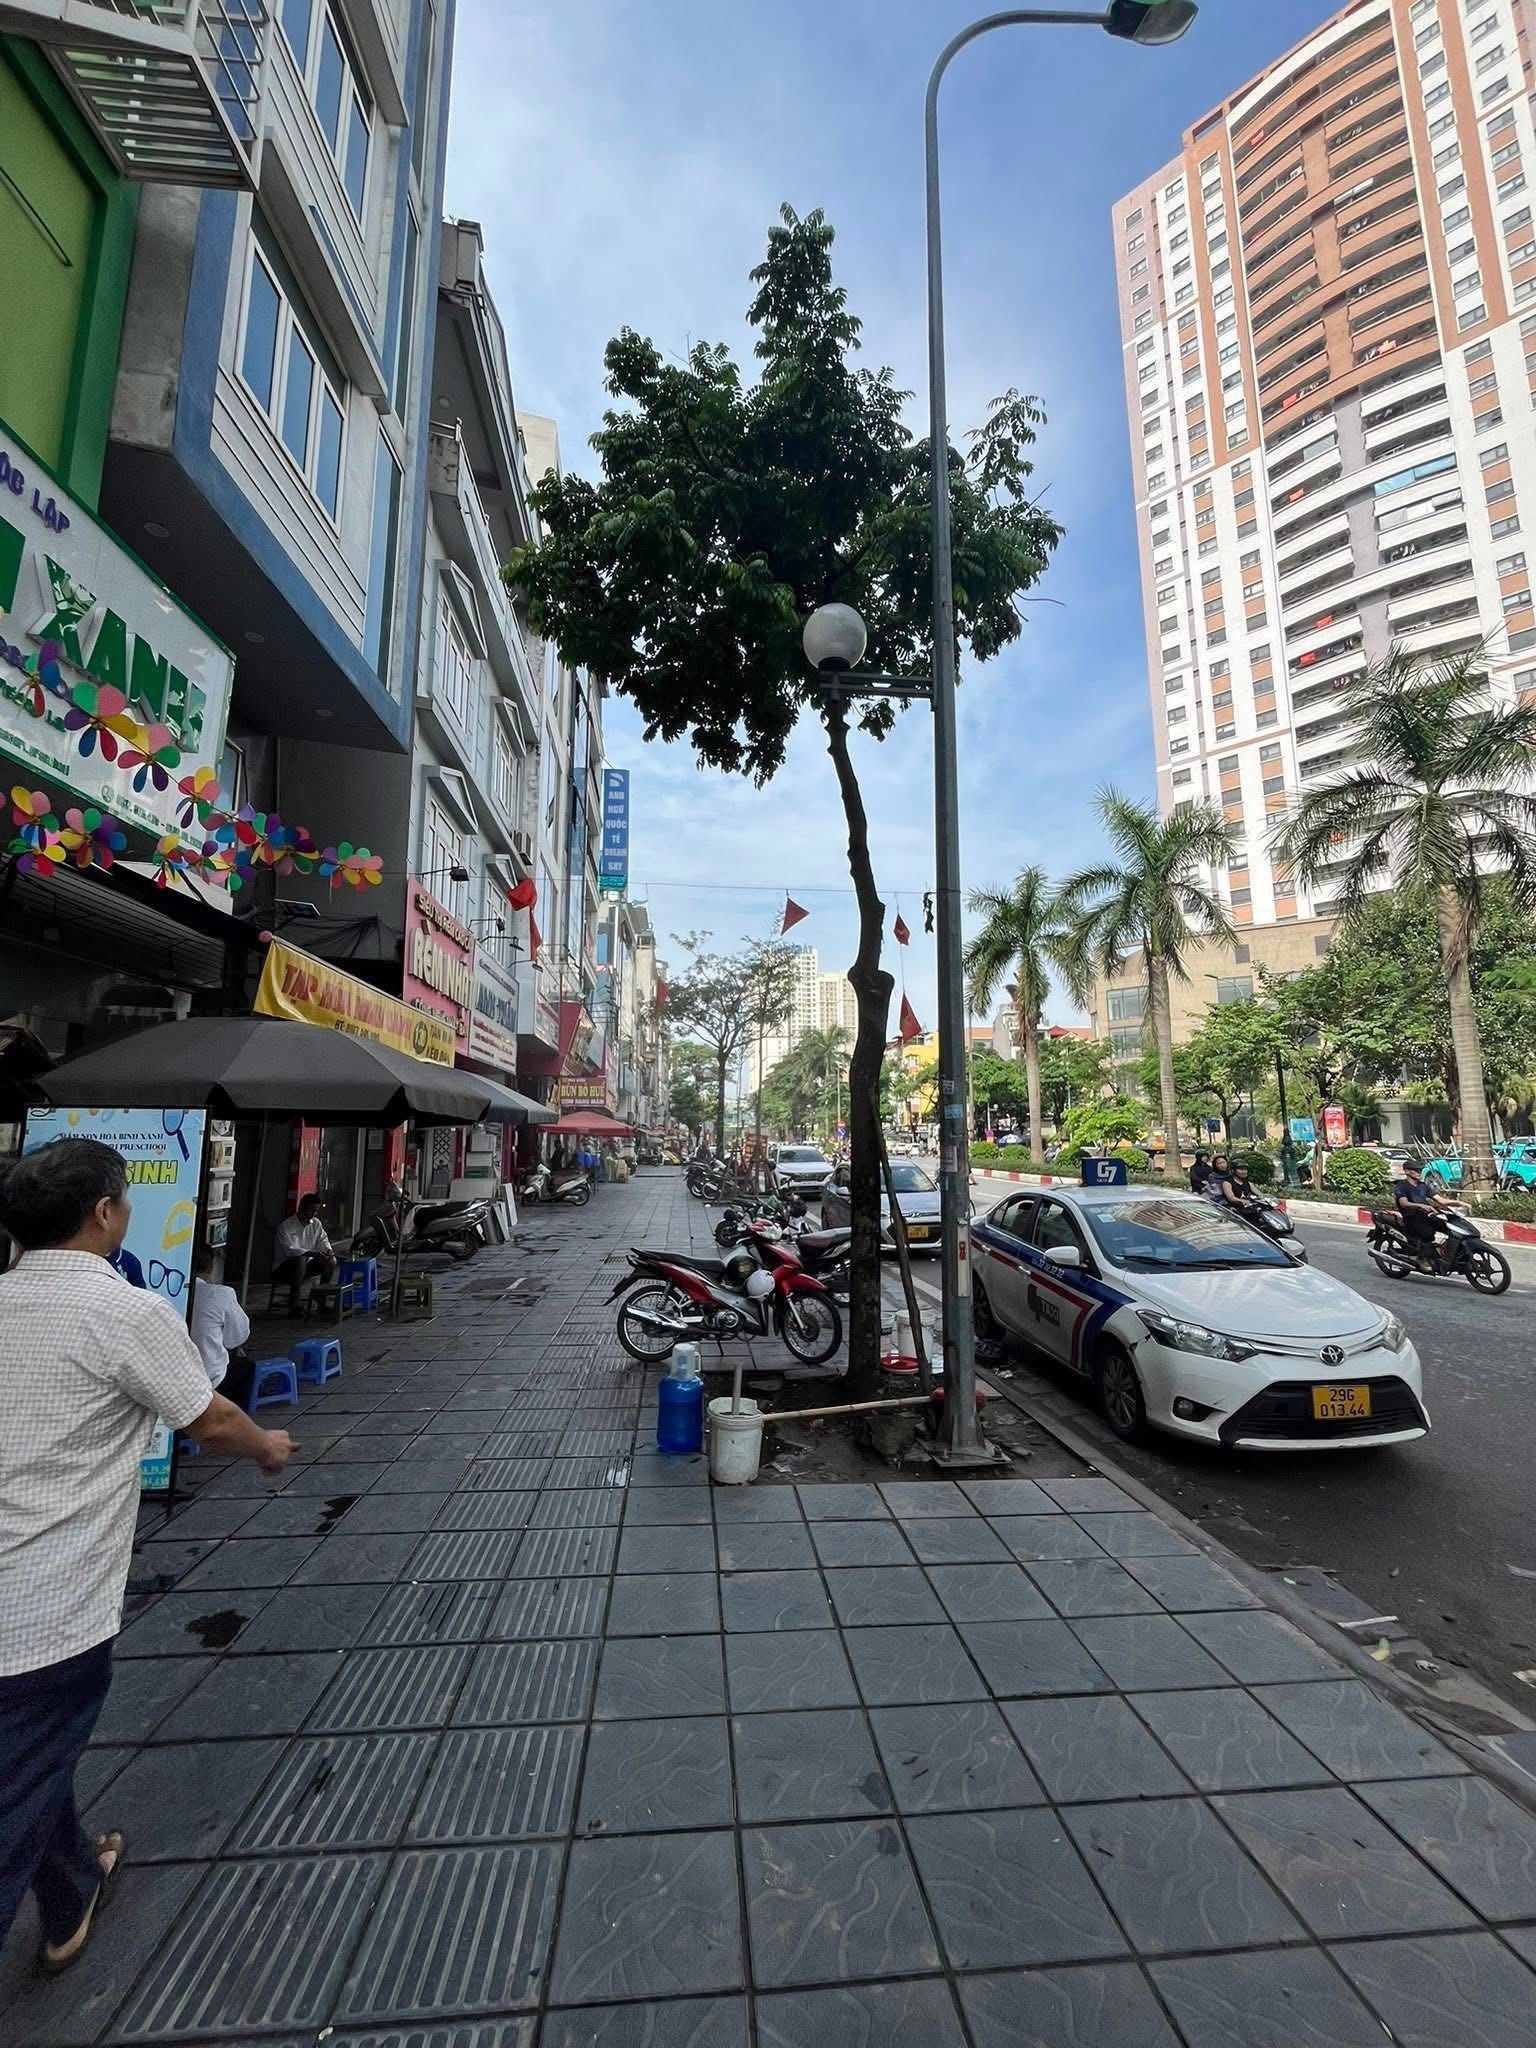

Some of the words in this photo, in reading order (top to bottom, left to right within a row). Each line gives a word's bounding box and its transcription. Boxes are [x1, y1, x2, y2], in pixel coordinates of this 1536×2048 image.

[1097, 1161, 1117, 1182] G7
[1329, 1388, 1355, 1402] 29G
[1320, 1403, 1365, 1416] 013.44
